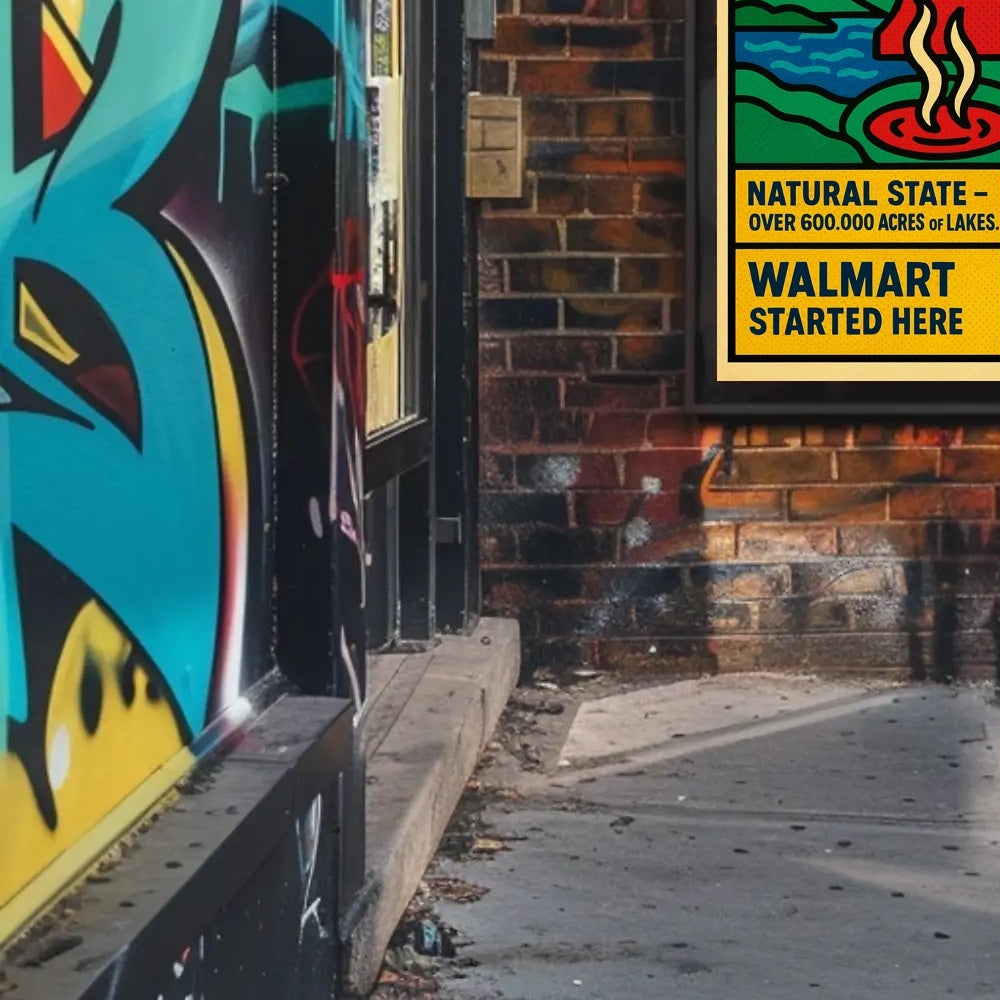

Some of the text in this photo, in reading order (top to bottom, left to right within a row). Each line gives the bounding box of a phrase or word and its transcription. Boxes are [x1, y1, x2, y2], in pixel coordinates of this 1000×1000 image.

[748, 180, 878, 206] NATURAL
[888, 180, 967, 206] STATE
[748, 213, 1000, 232] OVER 600.000 ACRES OF LAKES.
[748, 261, 956, 298] WALMART
[749, 307, 963, 336] STARTED HERE
